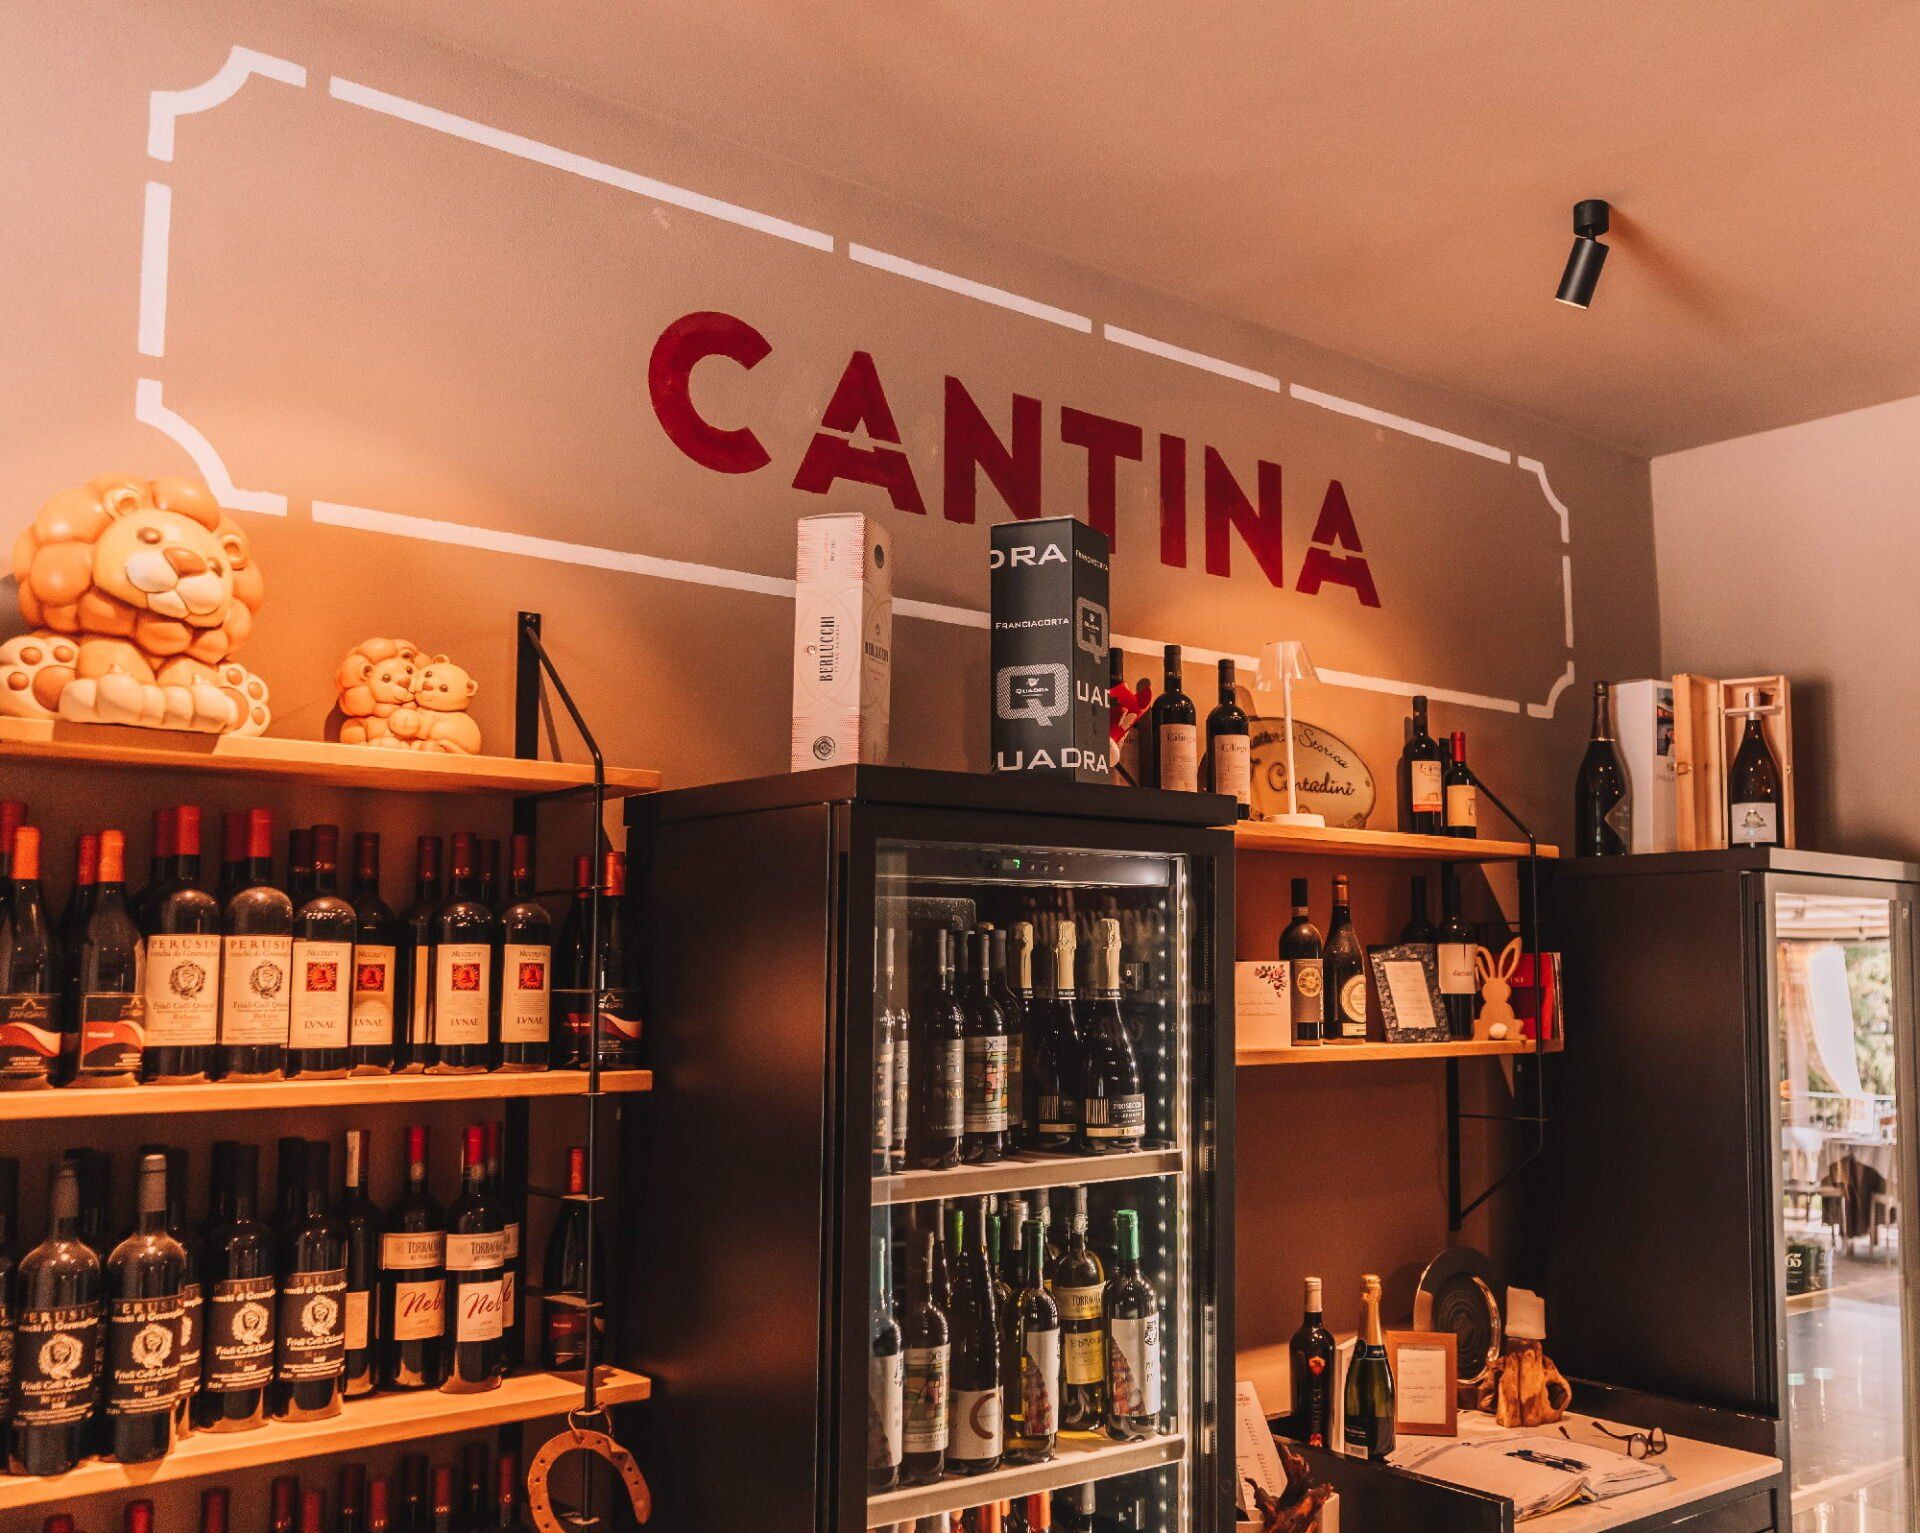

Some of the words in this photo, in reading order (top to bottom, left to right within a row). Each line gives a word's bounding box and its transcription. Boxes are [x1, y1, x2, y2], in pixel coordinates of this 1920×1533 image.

[648, 310, 1382, 608] CANTINA
[995, 617, 1070, 630] FRANCIACORTA
[819, 616, 835, 682] BERLUCCHI
[1015, 687, 1049, 695] QUADRA
[993, 747, 1109, 775] UADRA
[1298, 727, 1351, 770] Storica
